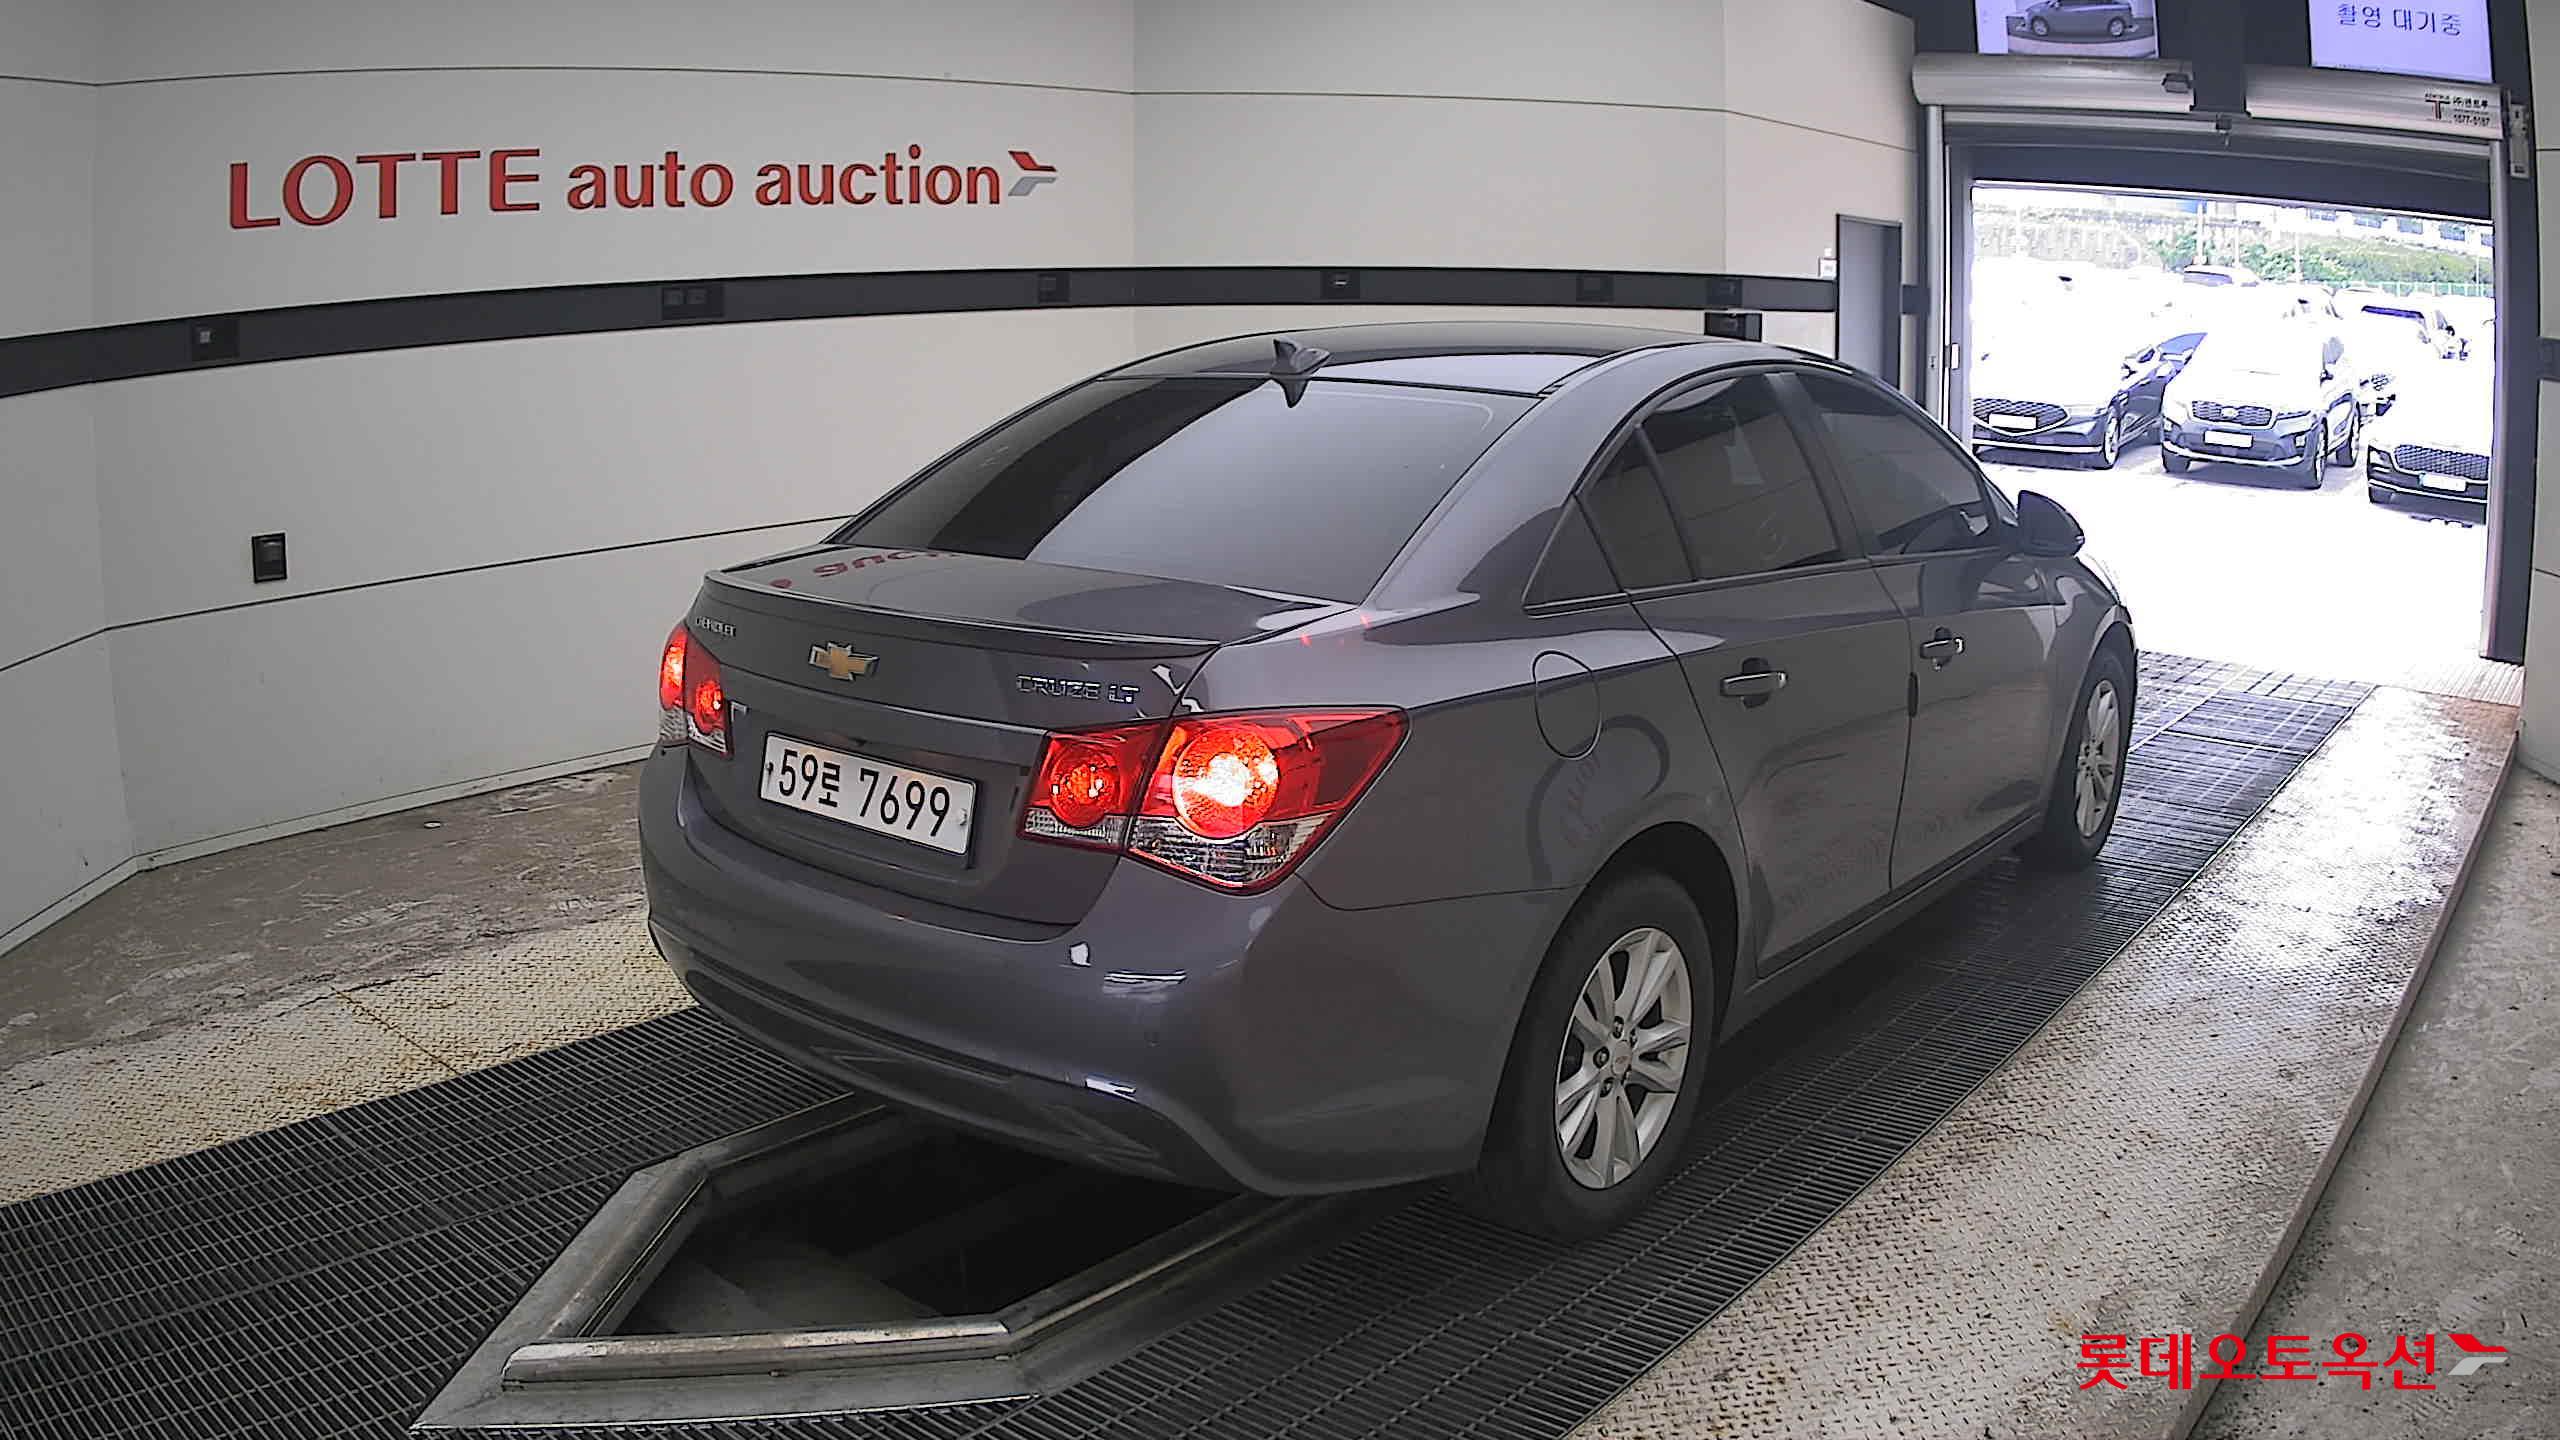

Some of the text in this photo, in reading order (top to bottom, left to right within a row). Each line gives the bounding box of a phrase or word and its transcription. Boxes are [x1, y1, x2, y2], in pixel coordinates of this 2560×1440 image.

[2338, 3, 2461, 36] 촬영 대기중
[230, 143, 1000, 229] LOTTE auto auction
[1016, 675, 1140, 703] CRUZE LT
[778, 748, 950, 837] 59로 7699
